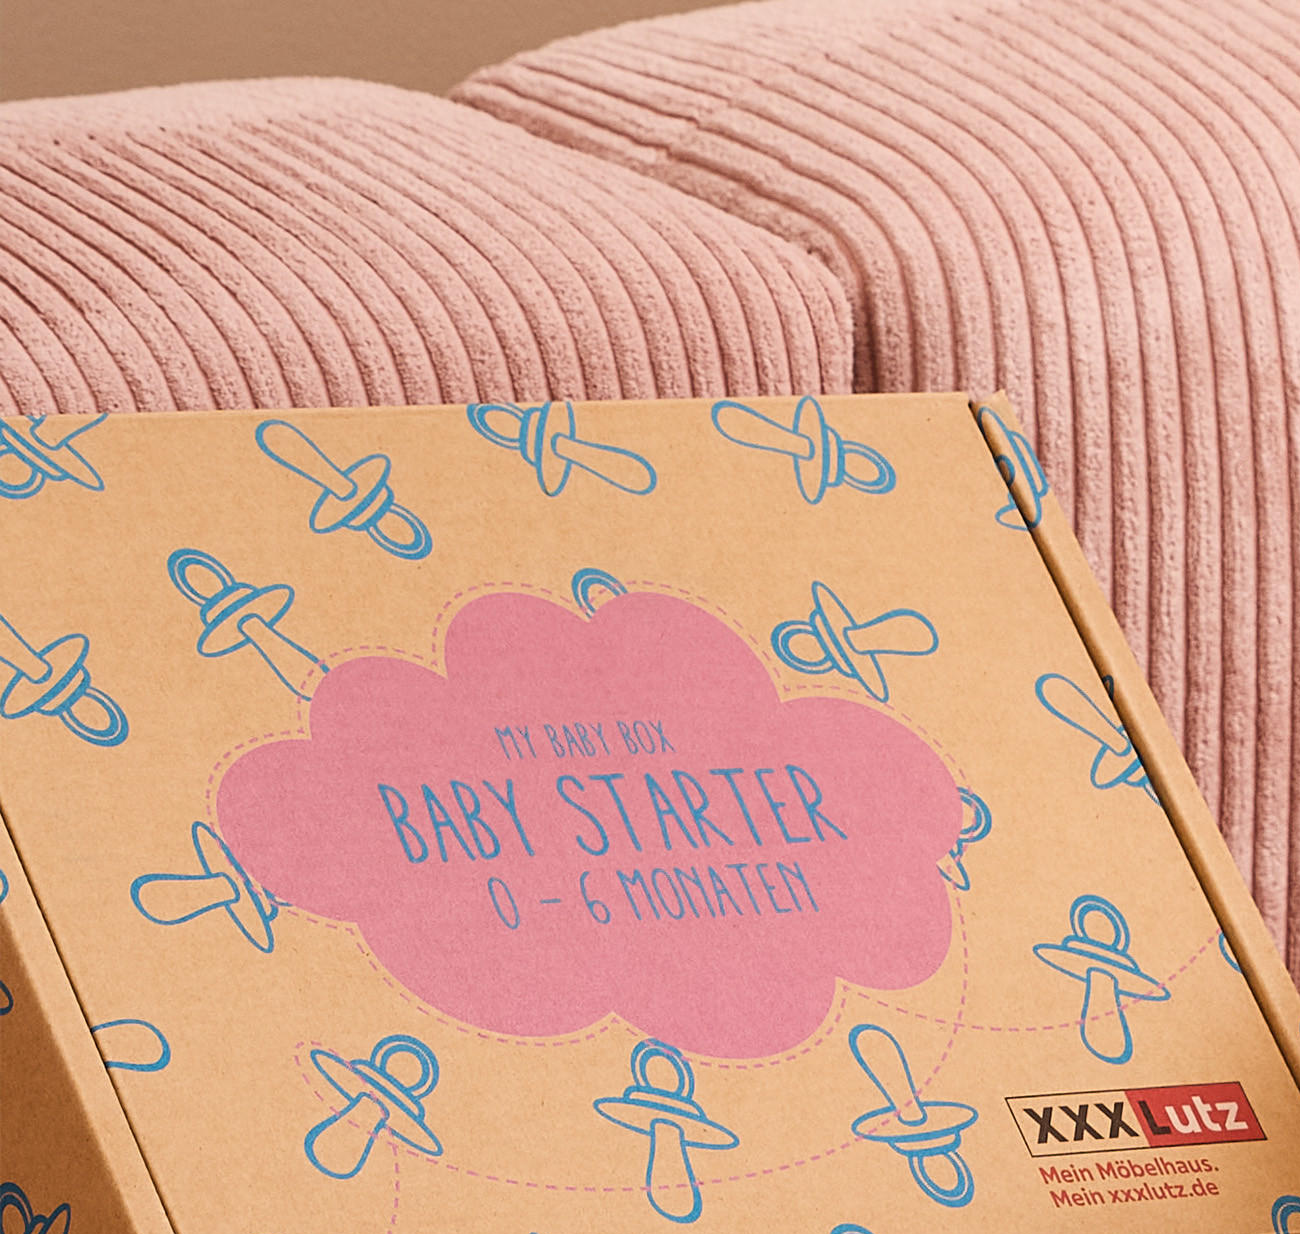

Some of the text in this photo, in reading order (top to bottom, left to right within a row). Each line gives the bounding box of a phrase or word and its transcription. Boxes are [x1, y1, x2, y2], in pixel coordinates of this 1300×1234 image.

[494, 720, 676, 760] MY BABY BOX
[377, 763, 848, 864] BABY STARTER
[486, 876, 520, 930] 0
[578, 870, 611, 925] 6
[615, 860, 820, 920] MONATEN
[1023, 1096, 1248, 1144] XXXLutz
[1037, 1157, 1220, 1185] Mein Möbelhaus.
[1049, 1178, 1220, 1209] Mein xxxlutz.de
